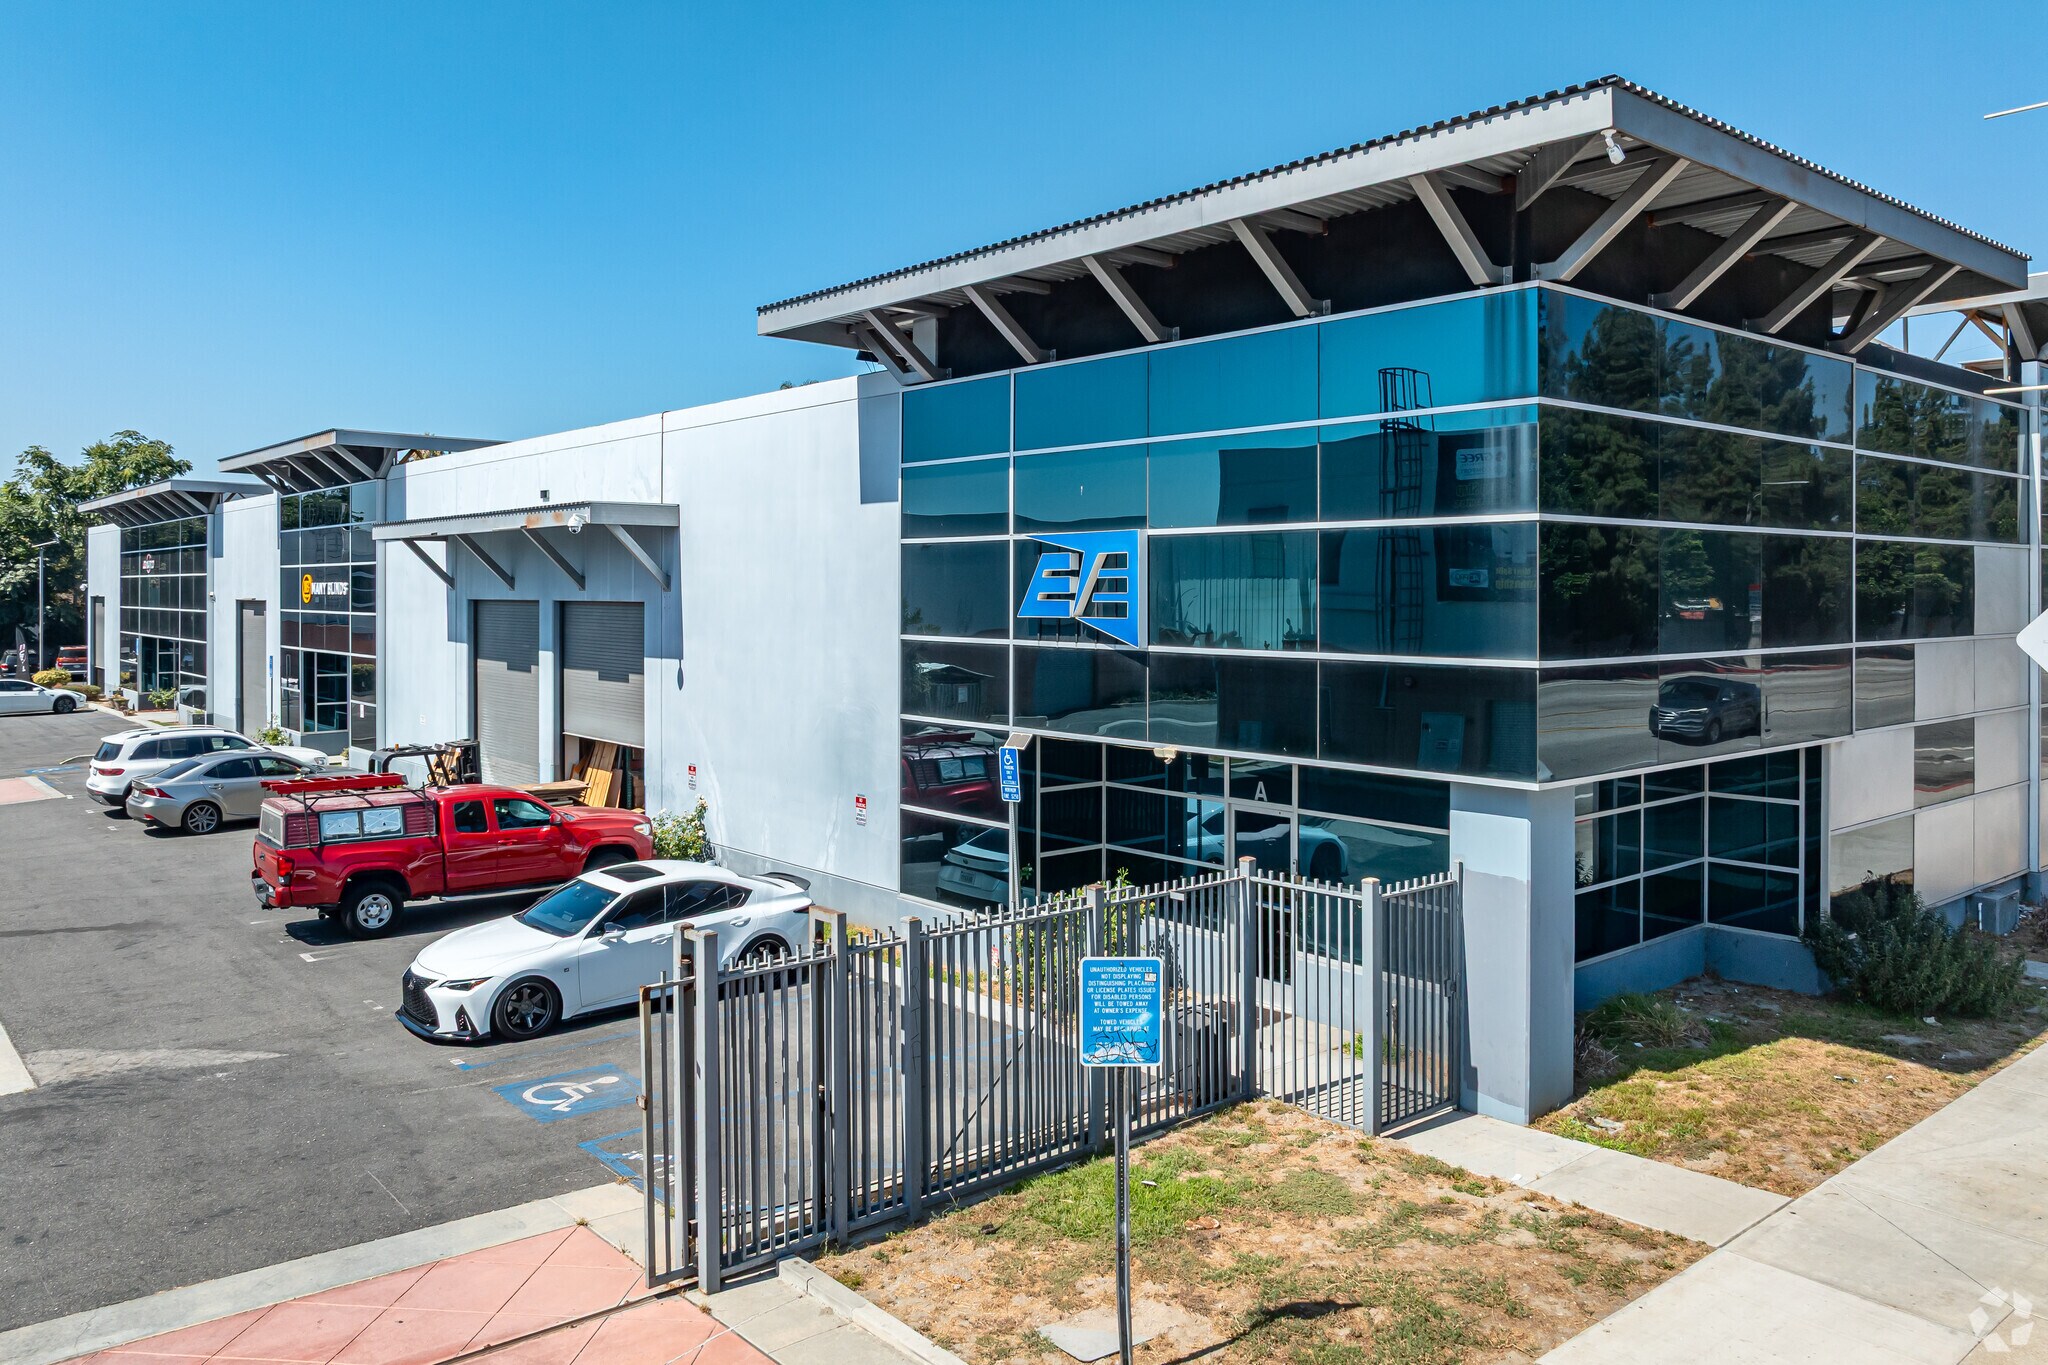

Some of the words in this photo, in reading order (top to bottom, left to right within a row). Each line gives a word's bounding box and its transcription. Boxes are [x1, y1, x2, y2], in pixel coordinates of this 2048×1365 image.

[312, 582, 326, 595] MANY
[327, 582, 348, 595] BLINDS
[1254, 781, 1268, 802] A
